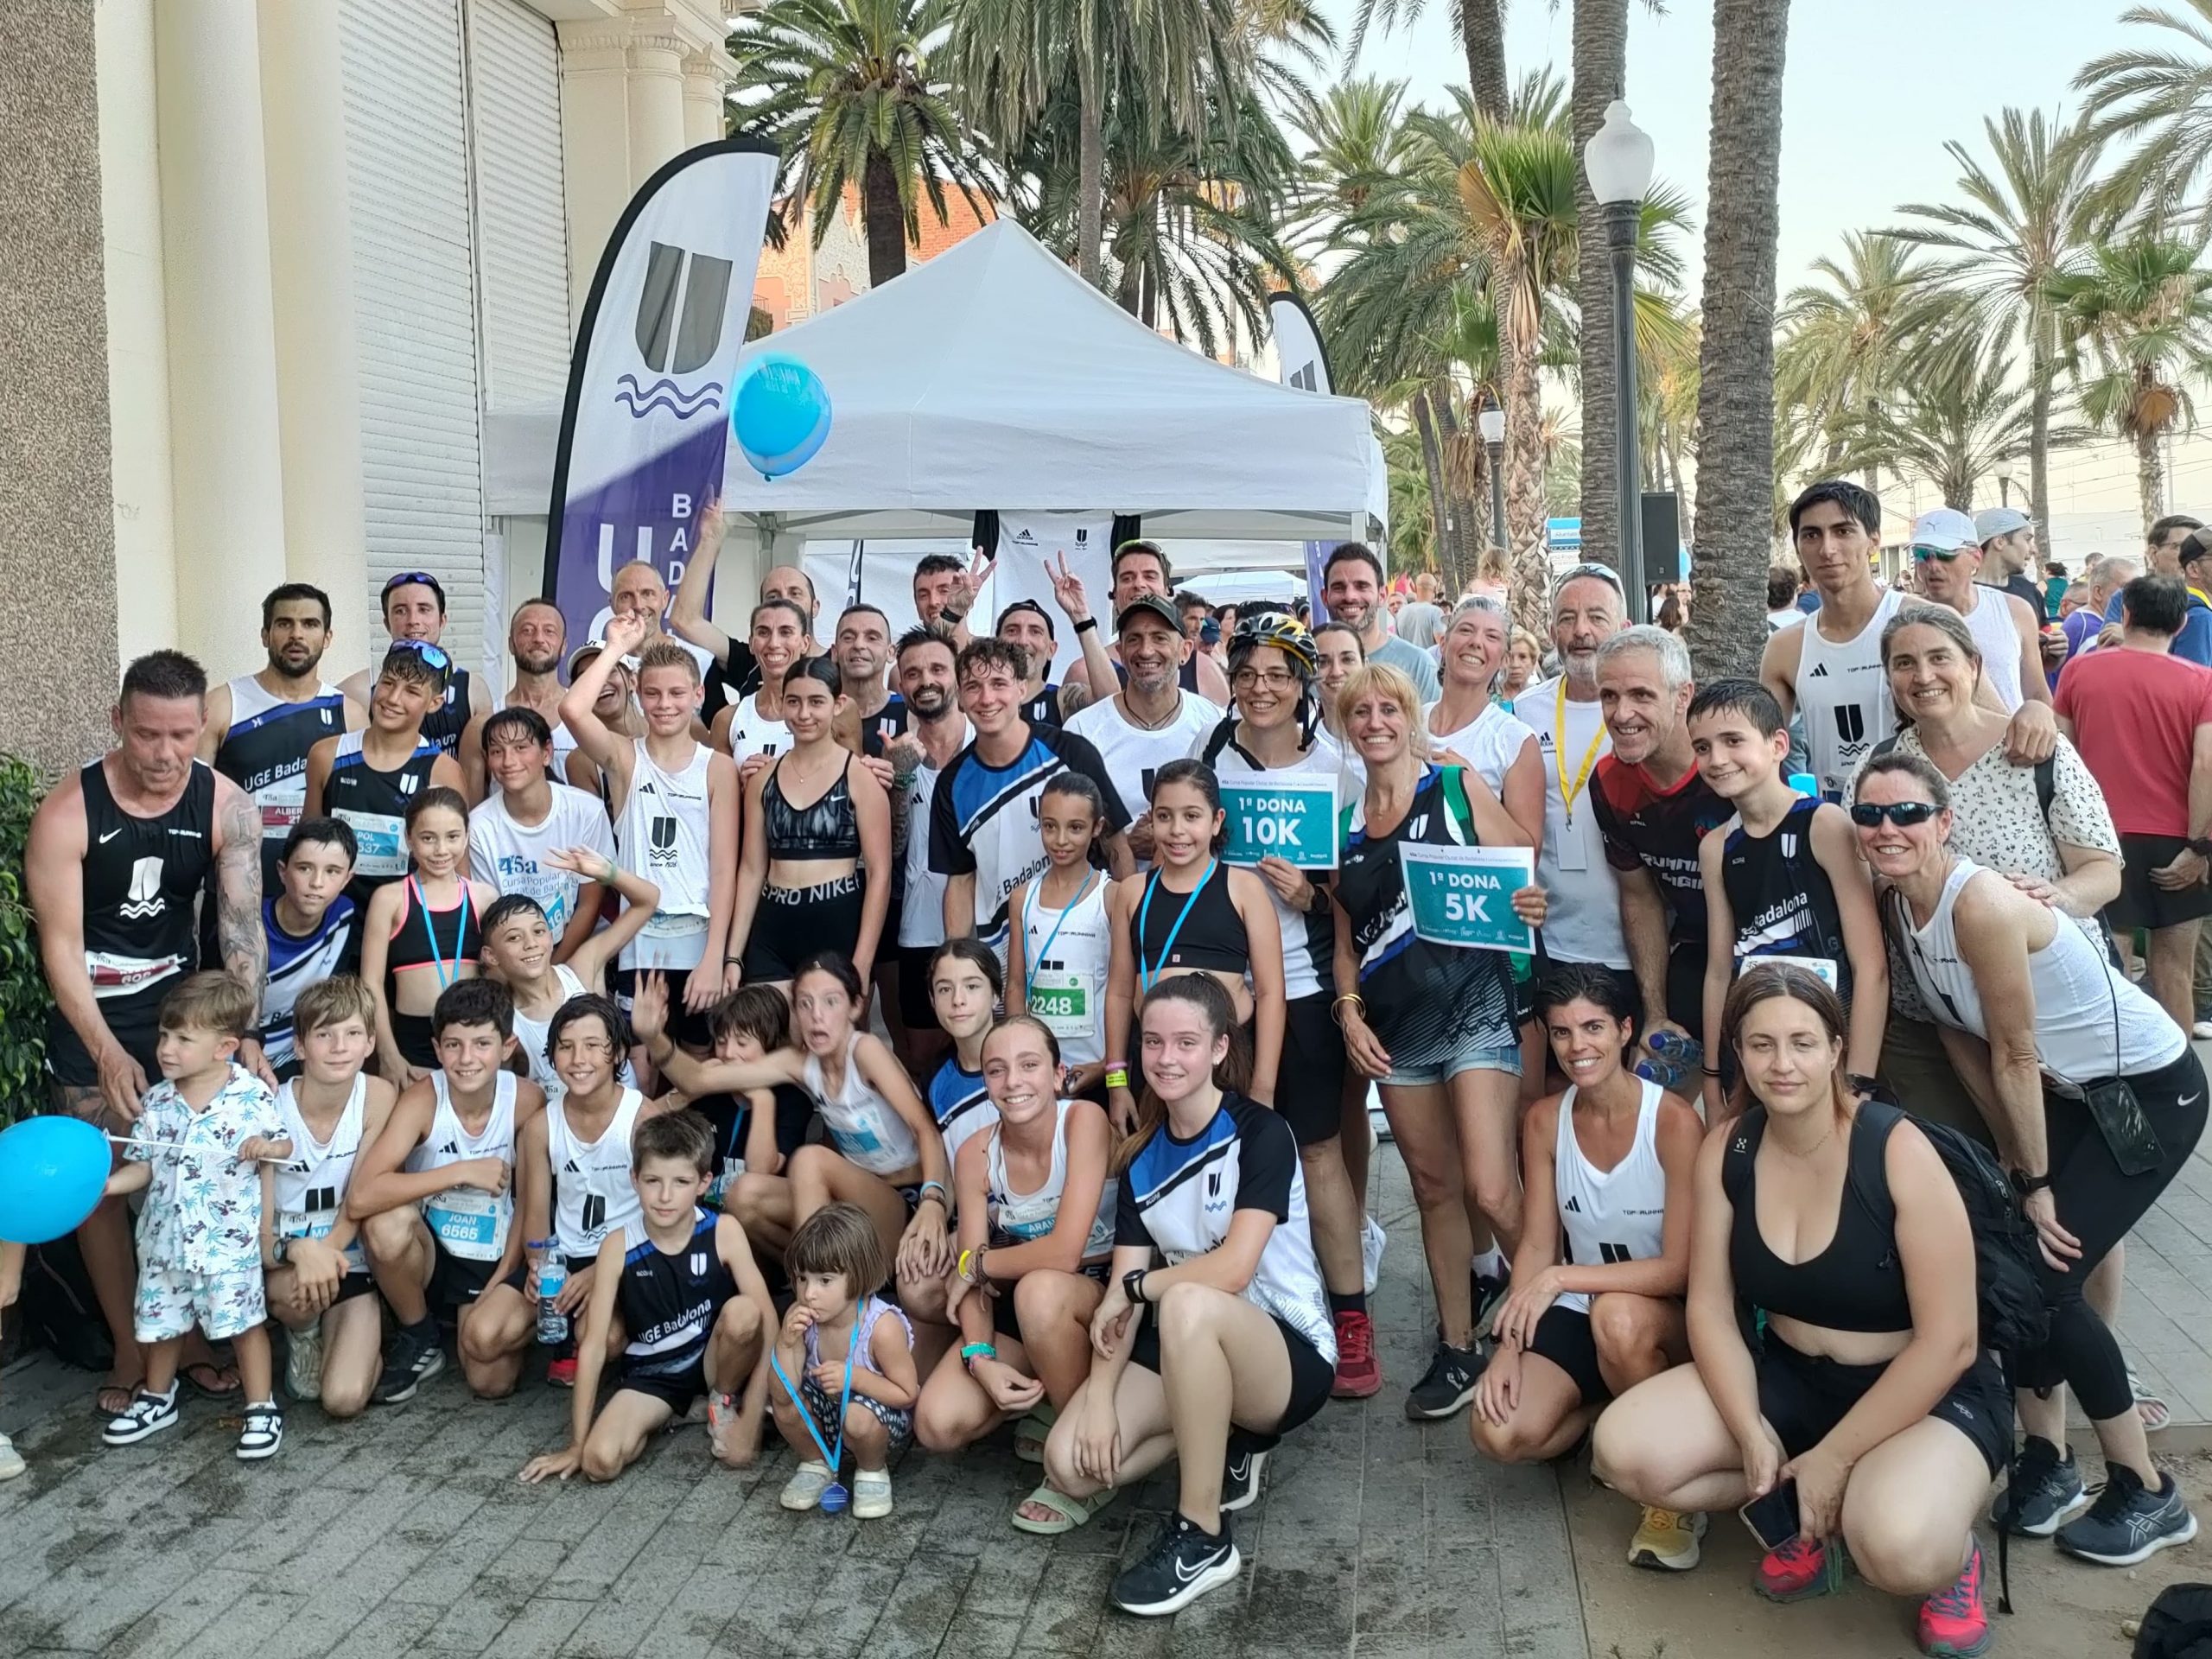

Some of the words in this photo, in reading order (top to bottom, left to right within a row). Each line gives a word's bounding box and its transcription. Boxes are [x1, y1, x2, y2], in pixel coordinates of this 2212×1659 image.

[245, 768, 271, 791] UGE
[1256, 798, 1306, 814] DONA
[1243, 816, 1302, 846] 10K
[499, 855, 539, 875] 45a
[766, 886, 802, 906] PRO
[809, 875, 855, 904] NIKE
[1448, 873, 1502, 891] DONA
[1446, 893, 1492, 923] 5K
[1031, 995, 1072, 1015] 2248
[448, 1213, 477, 1226] JOAN
[638, 1325, 662, 1344] UGE
